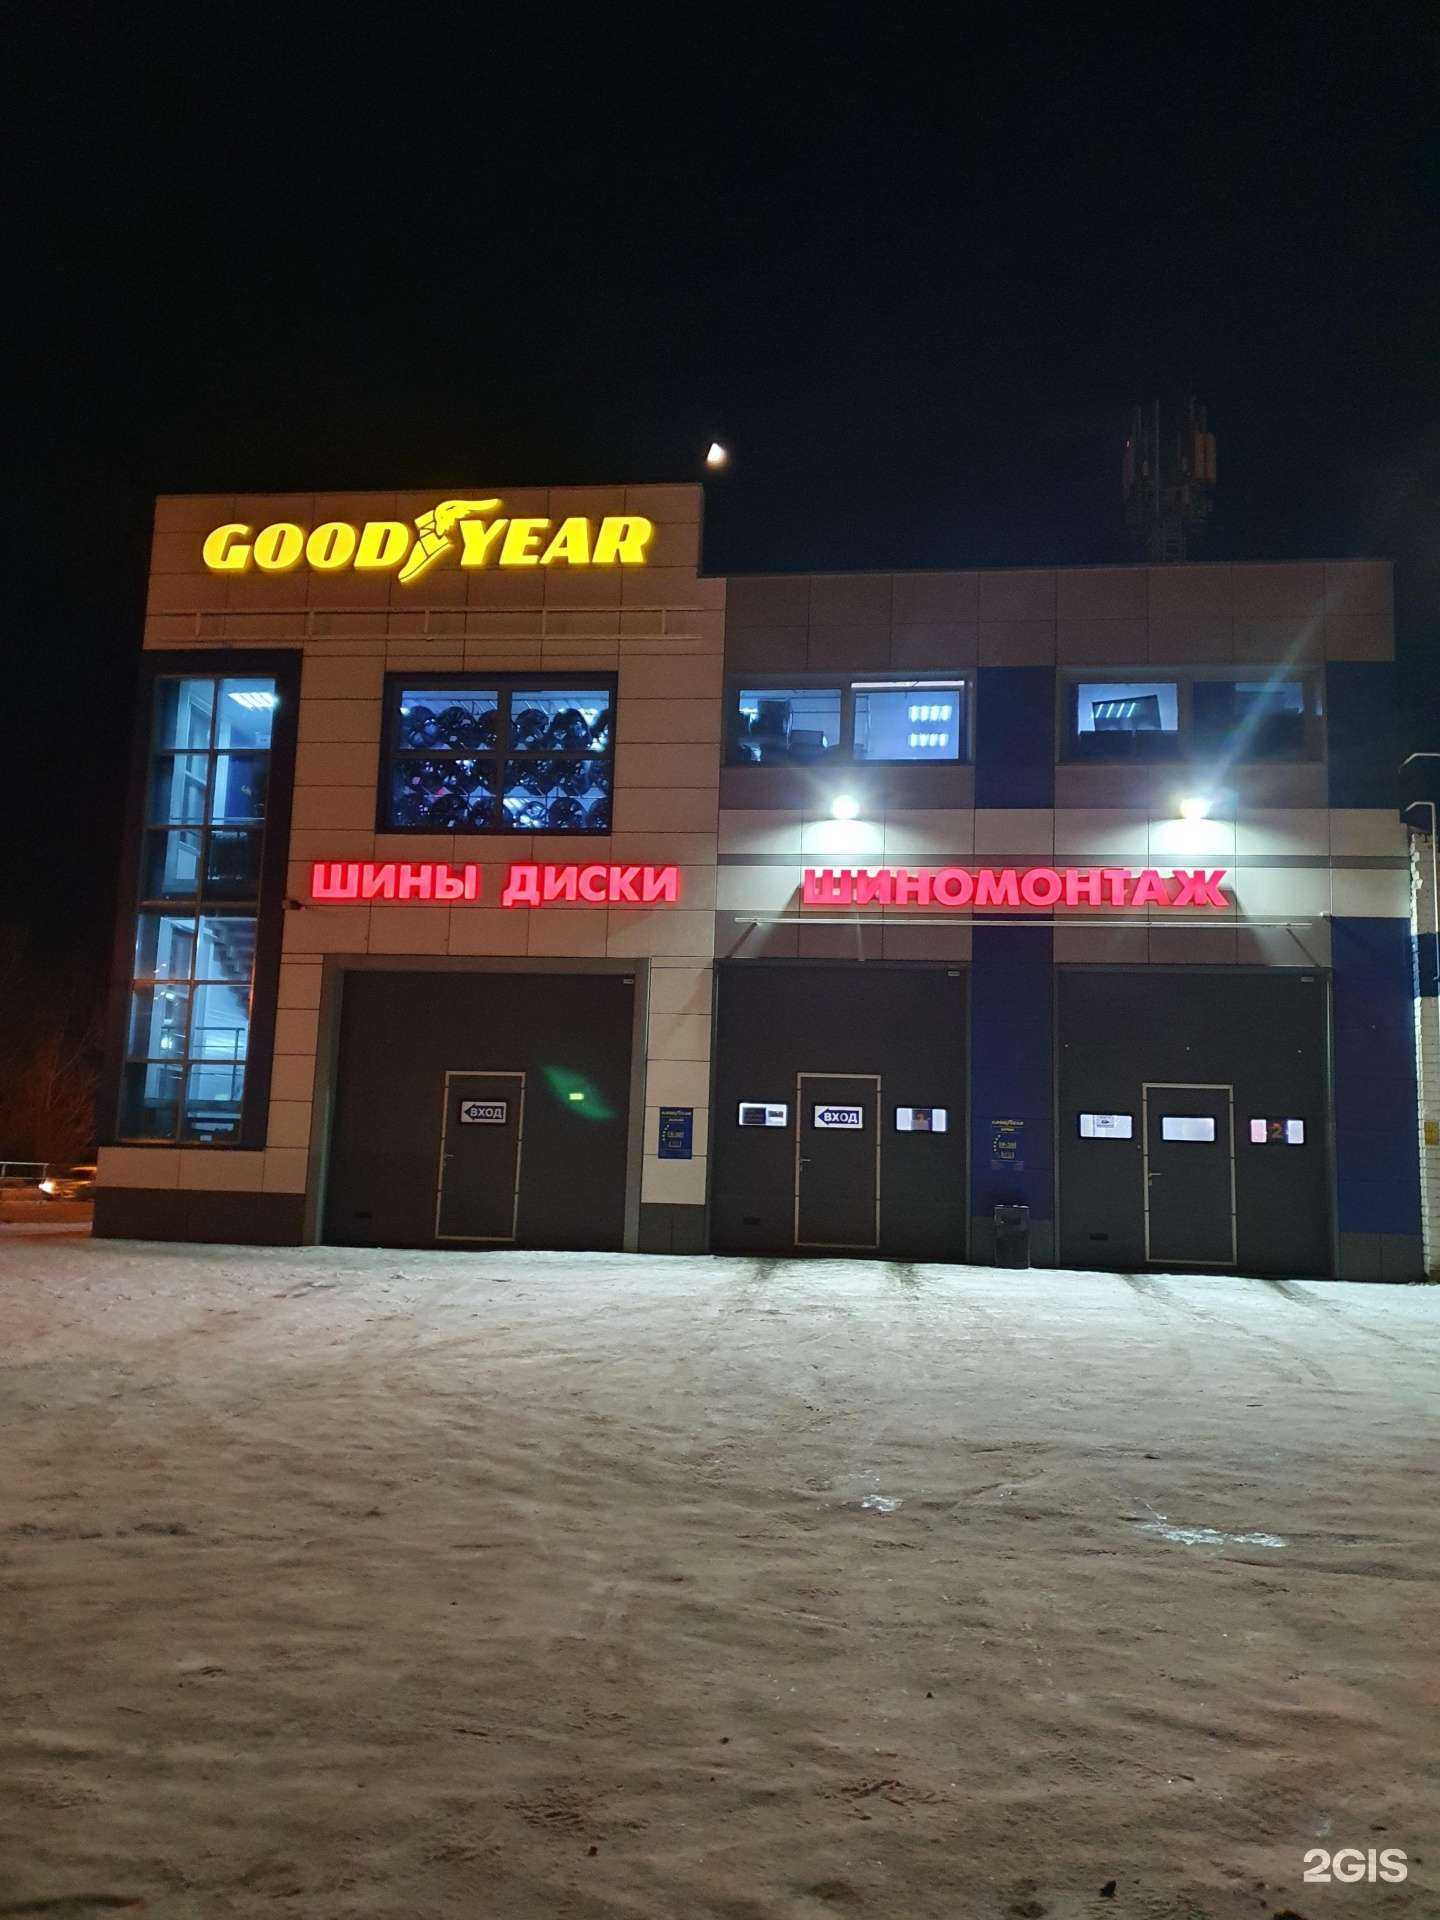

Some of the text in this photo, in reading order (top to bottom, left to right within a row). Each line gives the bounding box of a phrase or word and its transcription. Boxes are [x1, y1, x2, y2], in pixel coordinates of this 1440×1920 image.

[312, 863, 679, 907] ШИНЫ ДИСКИ
[802, 868, 1230, 908] ШИНОМОНТАЖ
[470, 1107, 503, 1118] ВХОД
[823, 1112, 858, 1124] ВХОД
